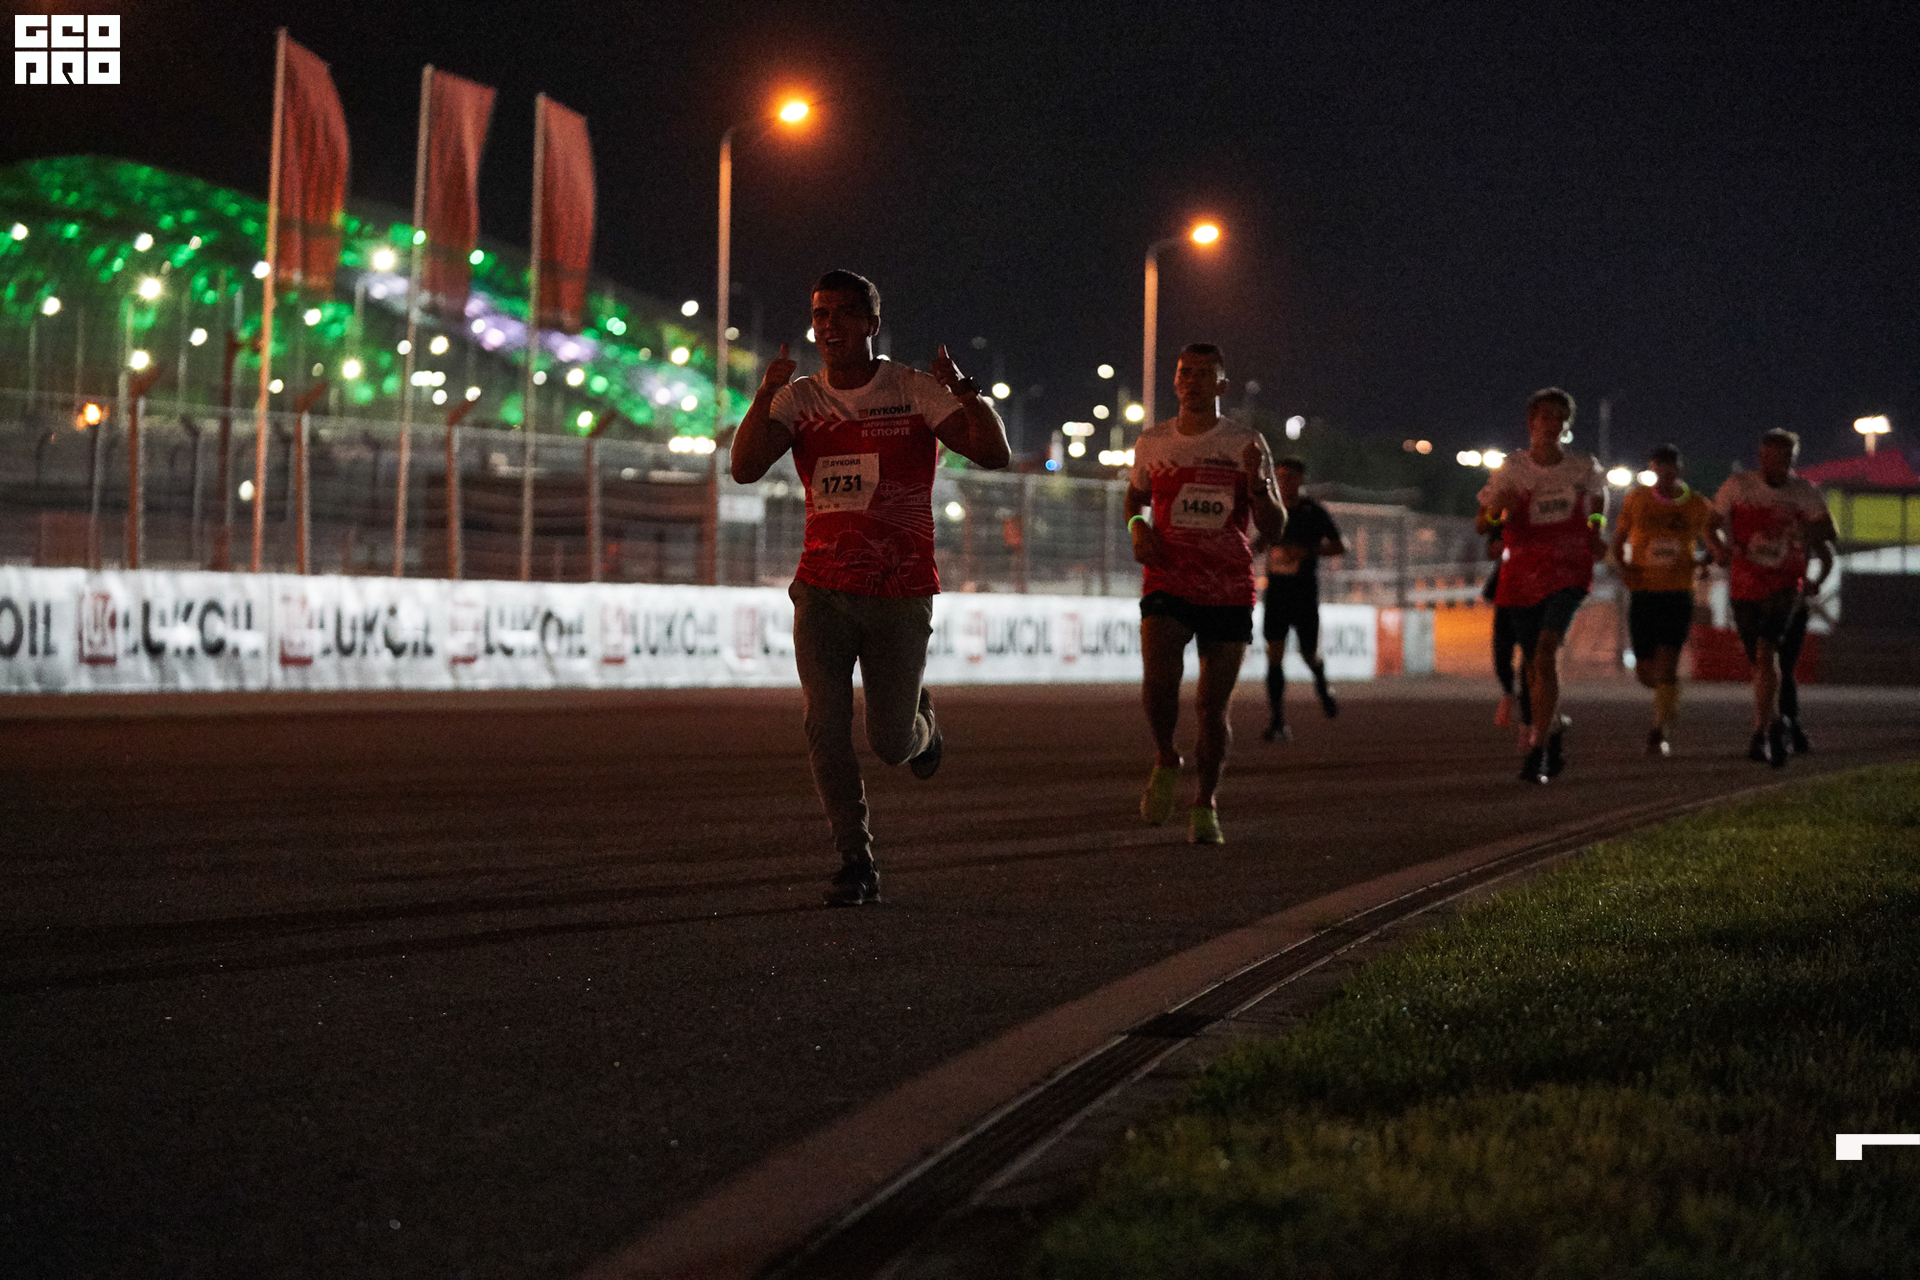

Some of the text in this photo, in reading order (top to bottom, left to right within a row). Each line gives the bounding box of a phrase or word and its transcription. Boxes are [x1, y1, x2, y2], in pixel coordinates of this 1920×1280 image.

[869, 404, 911, 416] ЛУКОЙЛ
[861, 427, 911, 437] В СПОРТЕ
[829, 458, 861, 467] ЛУКОЙЛ
[821, 474, 862, 494] 1731
[1182, 499, 1224, 515] 1480
